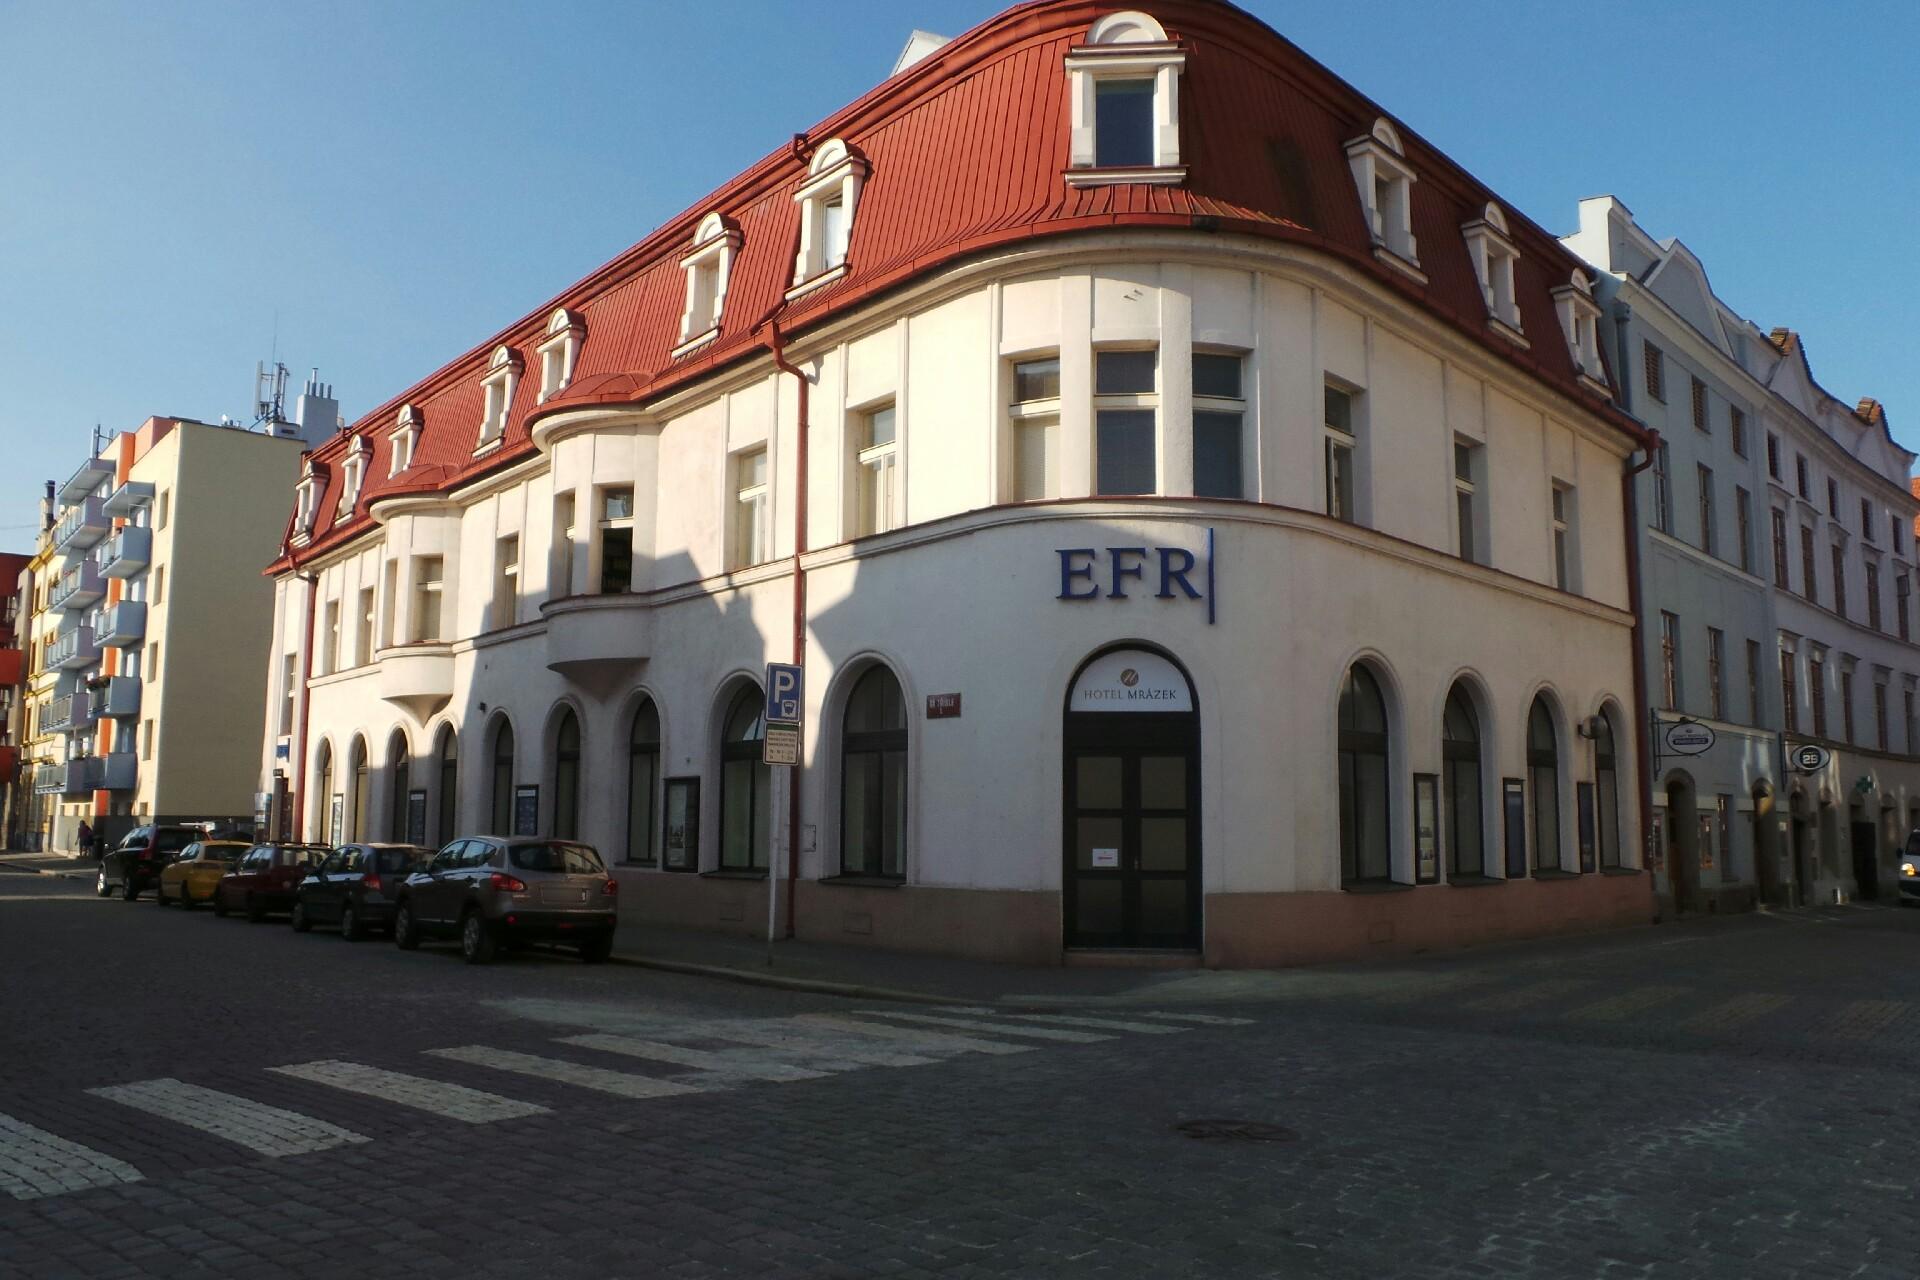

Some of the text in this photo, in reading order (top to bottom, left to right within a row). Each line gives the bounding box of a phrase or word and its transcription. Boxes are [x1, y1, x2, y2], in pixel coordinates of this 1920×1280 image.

[1055, 547, 1203, 599] EFR
[774, 671, 795, 703] P
[1084, 688, 1177, 700] HOTEL MRÁZEK
